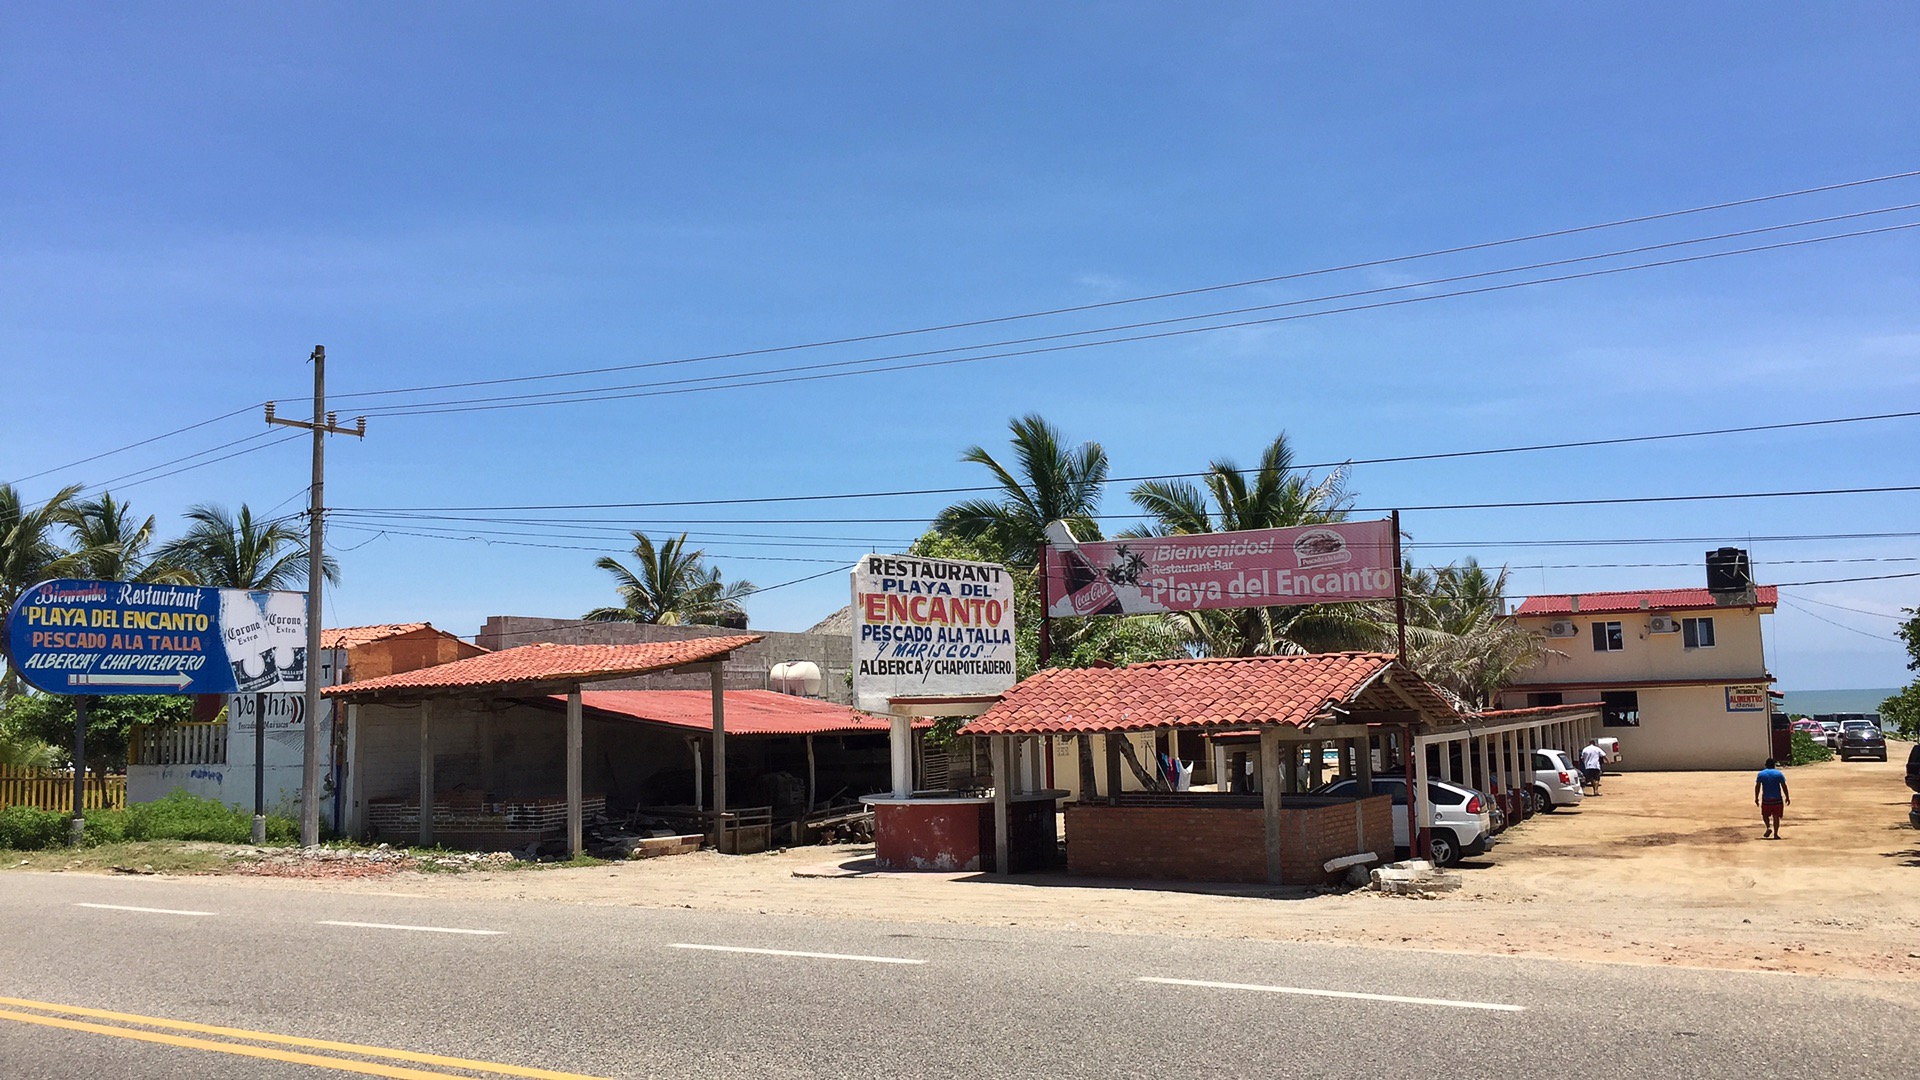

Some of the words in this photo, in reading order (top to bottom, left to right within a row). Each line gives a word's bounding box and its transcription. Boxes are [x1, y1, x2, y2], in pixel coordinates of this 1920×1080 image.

[1152, 537, 1275, 561] ¡Bienvenidos!
[869, 557, 1004, 583] RESTAURANT
[1152, 560, 1234, 575] Restaurant-Bar
[116, 583, 205, 610] Restaurant
[882, 578, 952, 596] PLAYA
[961, 583, 992, 597] DEL
[1152, 576, 1221, 608] Playa
[1228, 570, 1269, 599] del
[1277, 567, 1391, 595] Encanto
[91, 609, 120, 628] DEL
[267, 613, 302, 626] Corona
[224, 621, 262, 642] Corona
[276, 626, 297, 634] Extra
[862, 625, 932, 643] PESCADO
[966, 627, 1011, 644] TALLA
[32, 631, 107, 649] PESCADO
[148, 635, 202, 651] TALLA
[237, 634, 259, 646] Extra
[24, 653, 92, 669] ALBERCA
[100, 654, 206, 671] CHAPOTEADERO
[859, 660, 924, 676] ALBERCA
[934, 660, 1015, 675] CHAPOTEADERO.
[1730, 695, 1763, 703] ALIMENTOS
